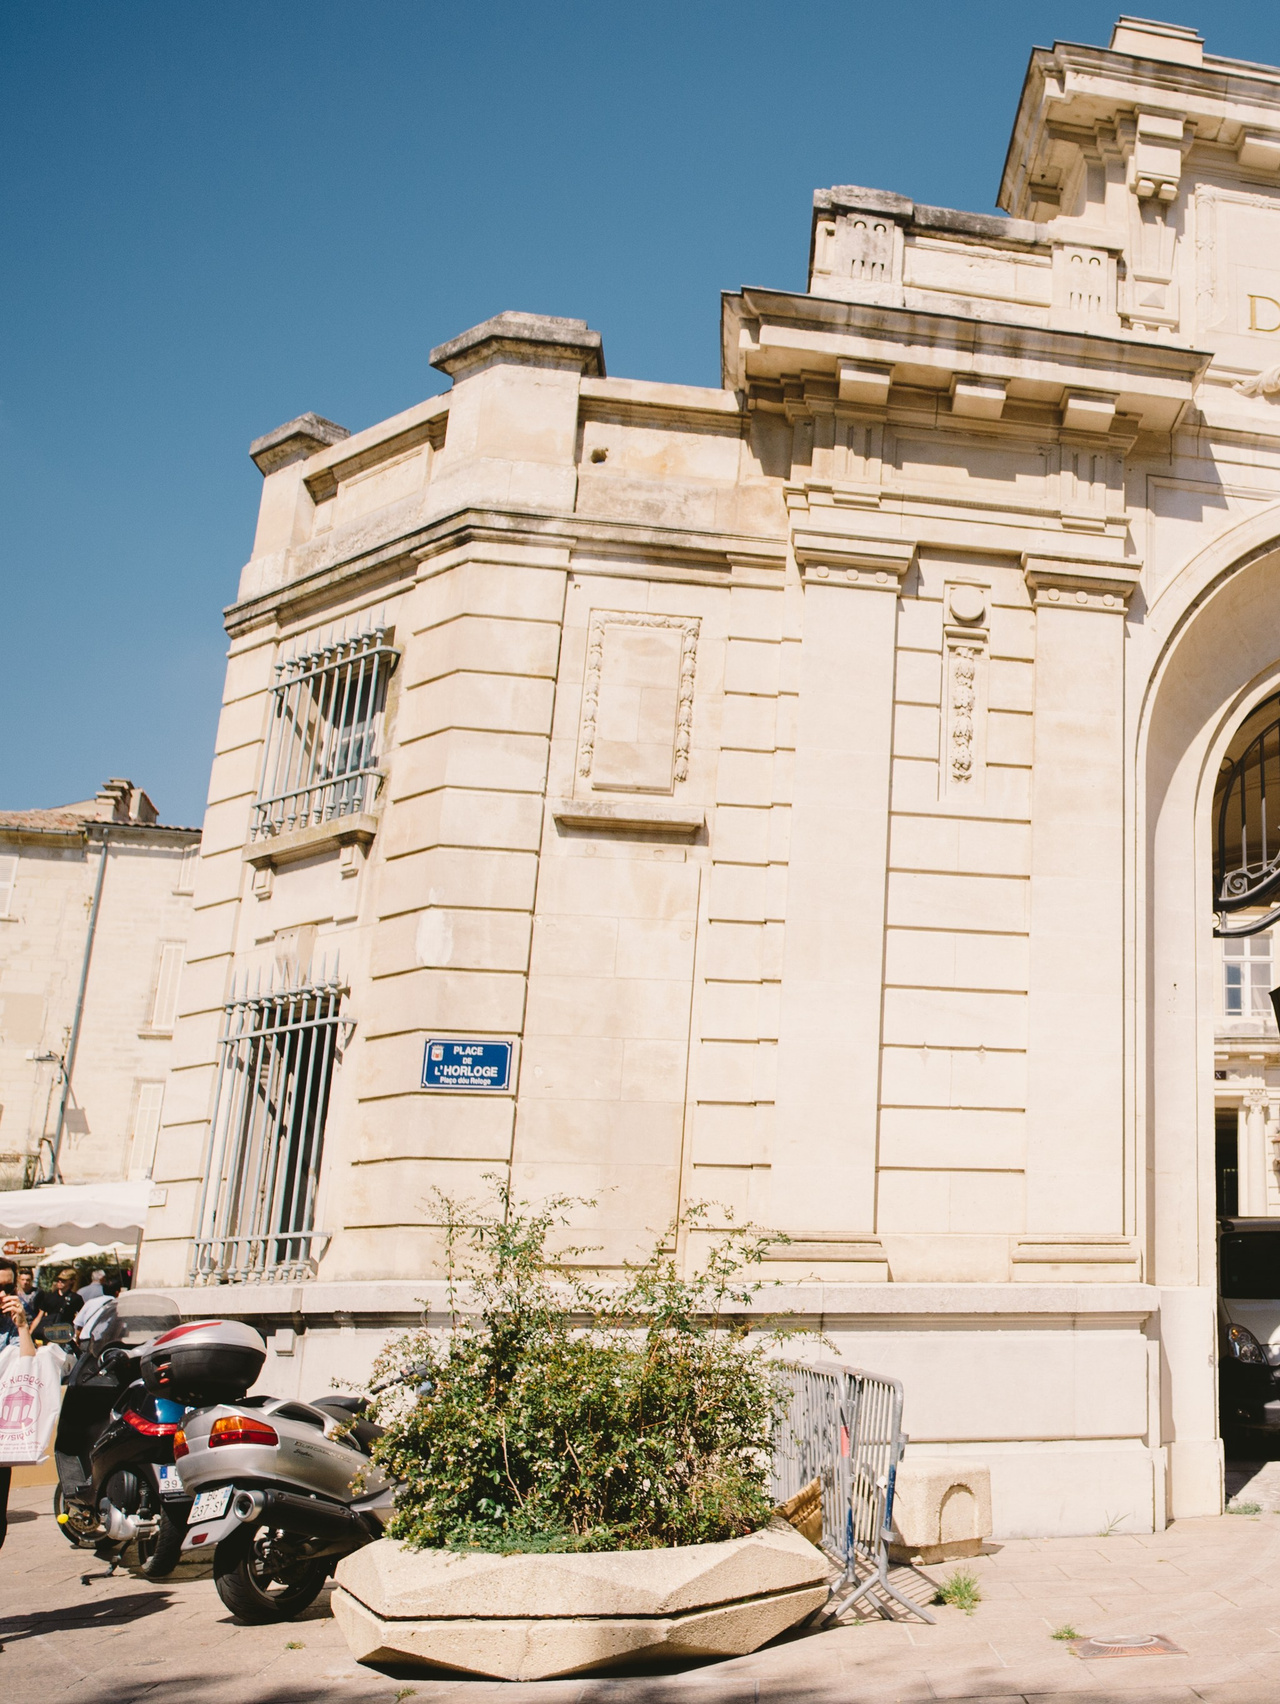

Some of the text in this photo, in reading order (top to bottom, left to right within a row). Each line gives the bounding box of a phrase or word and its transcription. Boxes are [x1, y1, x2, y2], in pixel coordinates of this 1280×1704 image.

[453, 1046, 484, 1056] PLACE
[462, 1057, 473, 1065] DE
[434, 1065, 498, 1077] L'HORLOGE
